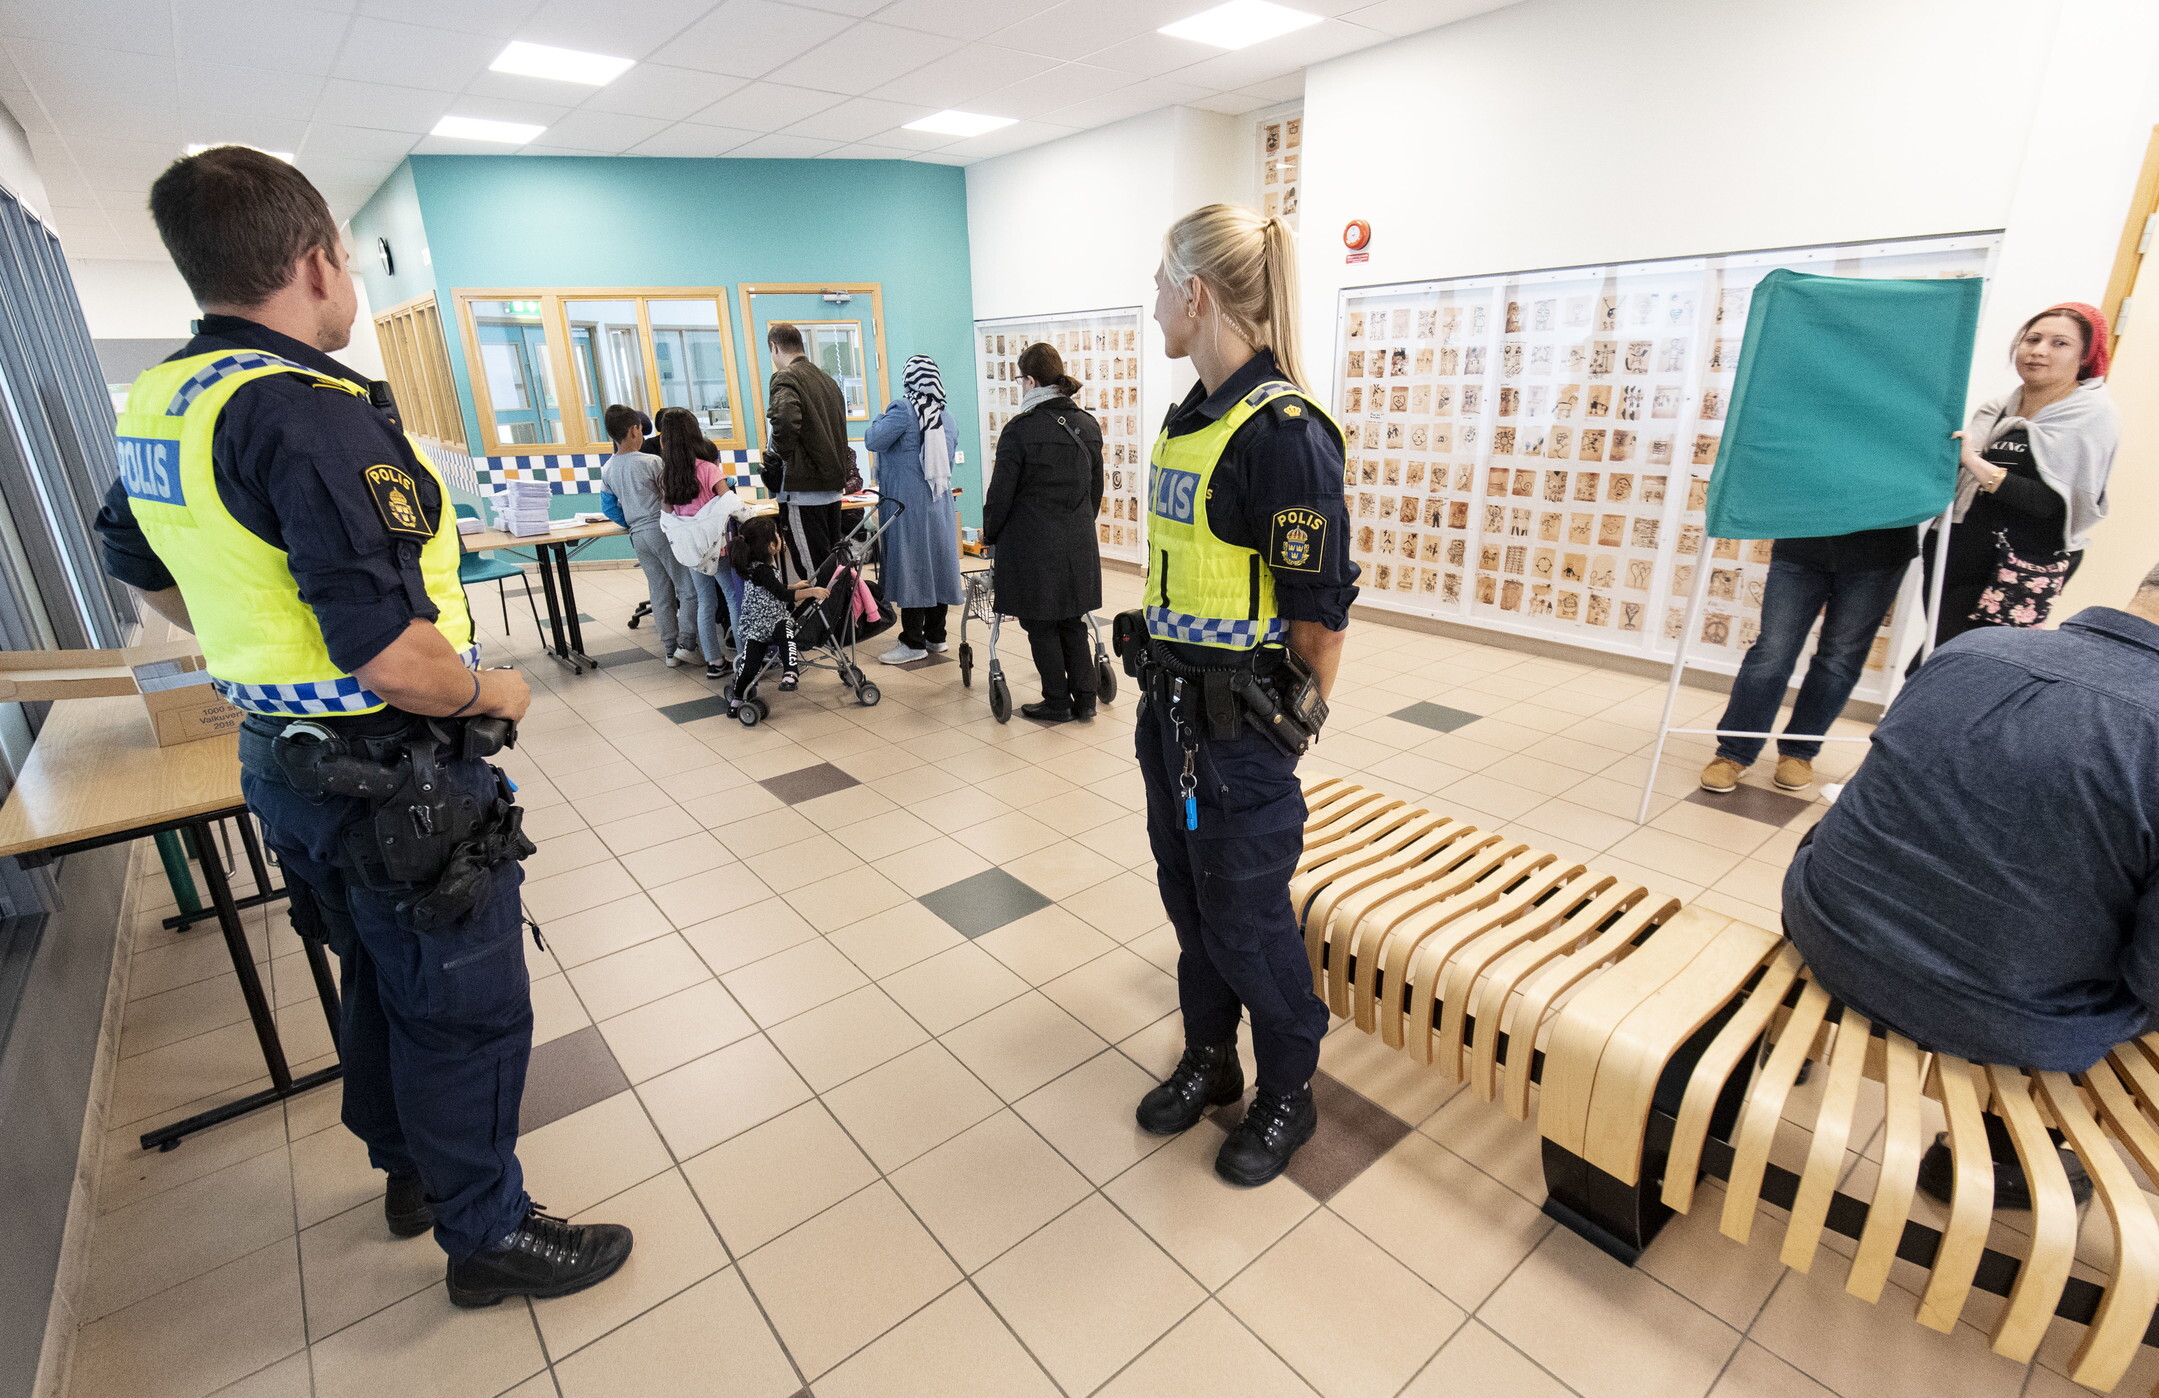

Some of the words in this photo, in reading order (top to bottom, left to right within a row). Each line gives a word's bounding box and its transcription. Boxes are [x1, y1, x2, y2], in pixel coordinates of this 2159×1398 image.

[369, 468, 411, 490] POLIS
[1277, 511, 1323, 530] POLIS
[199, 710, 244, 724] Valkuvert
[202, 706, 225, 716] 1000
[213, 720, 235, 730] 2018
